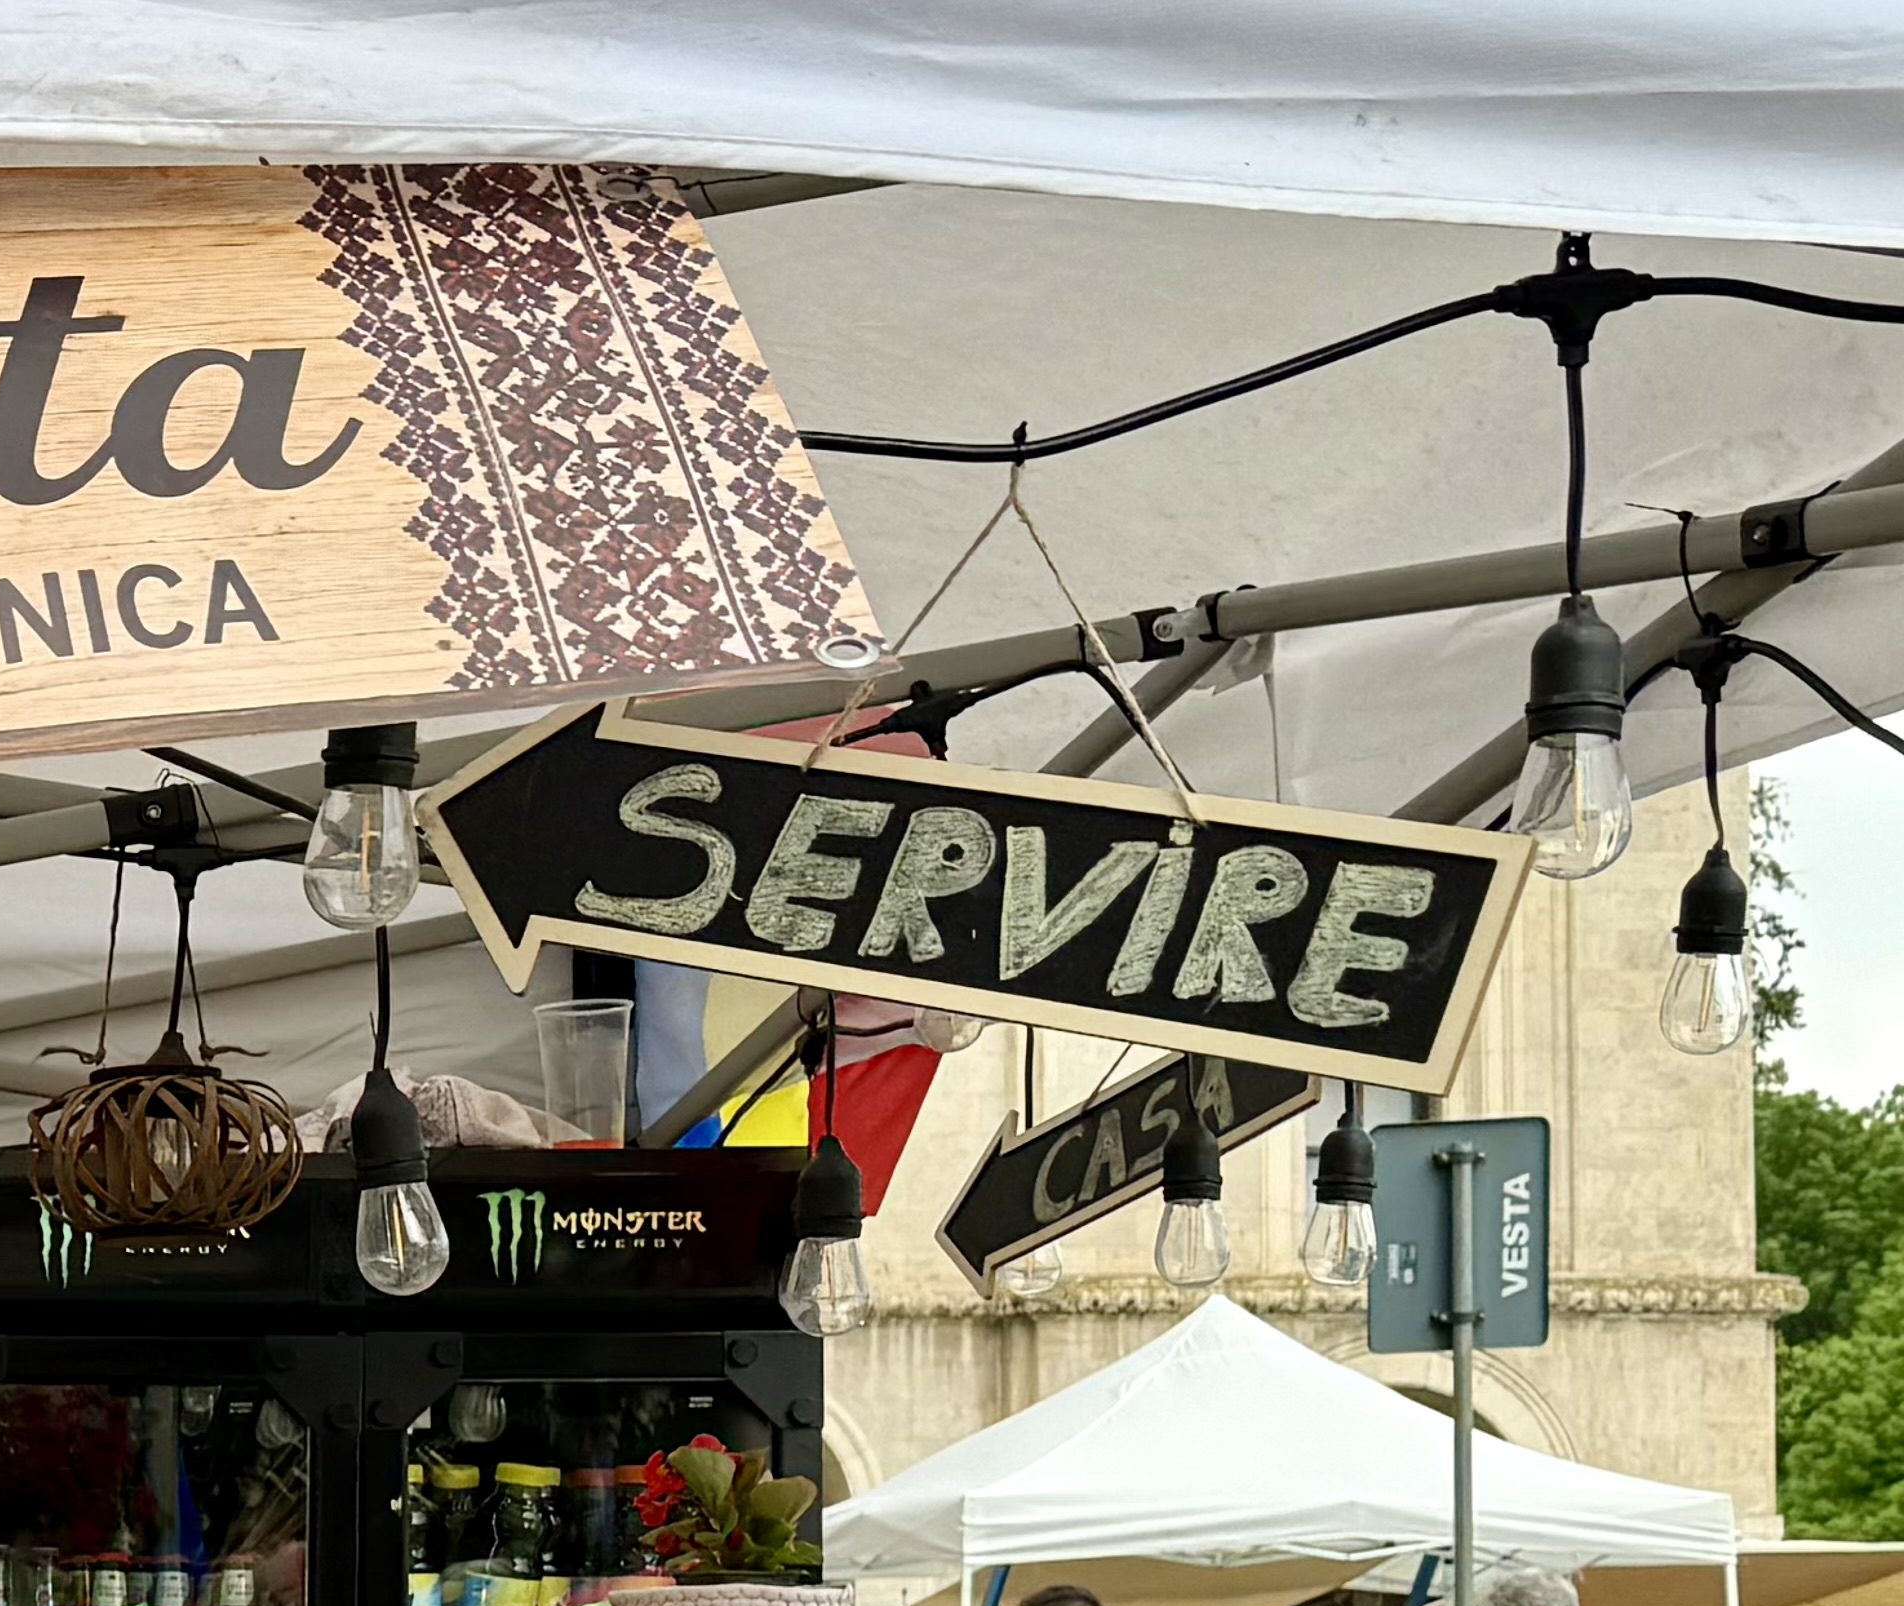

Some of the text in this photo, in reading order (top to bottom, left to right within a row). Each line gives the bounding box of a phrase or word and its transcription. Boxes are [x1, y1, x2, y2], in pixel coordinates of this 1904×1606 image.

[1033, 1058, 1235, 1223] CASA
[553, 1207, 707, 1236] MONSTER
[1501, 1173, 1530, 1298] VESTA
